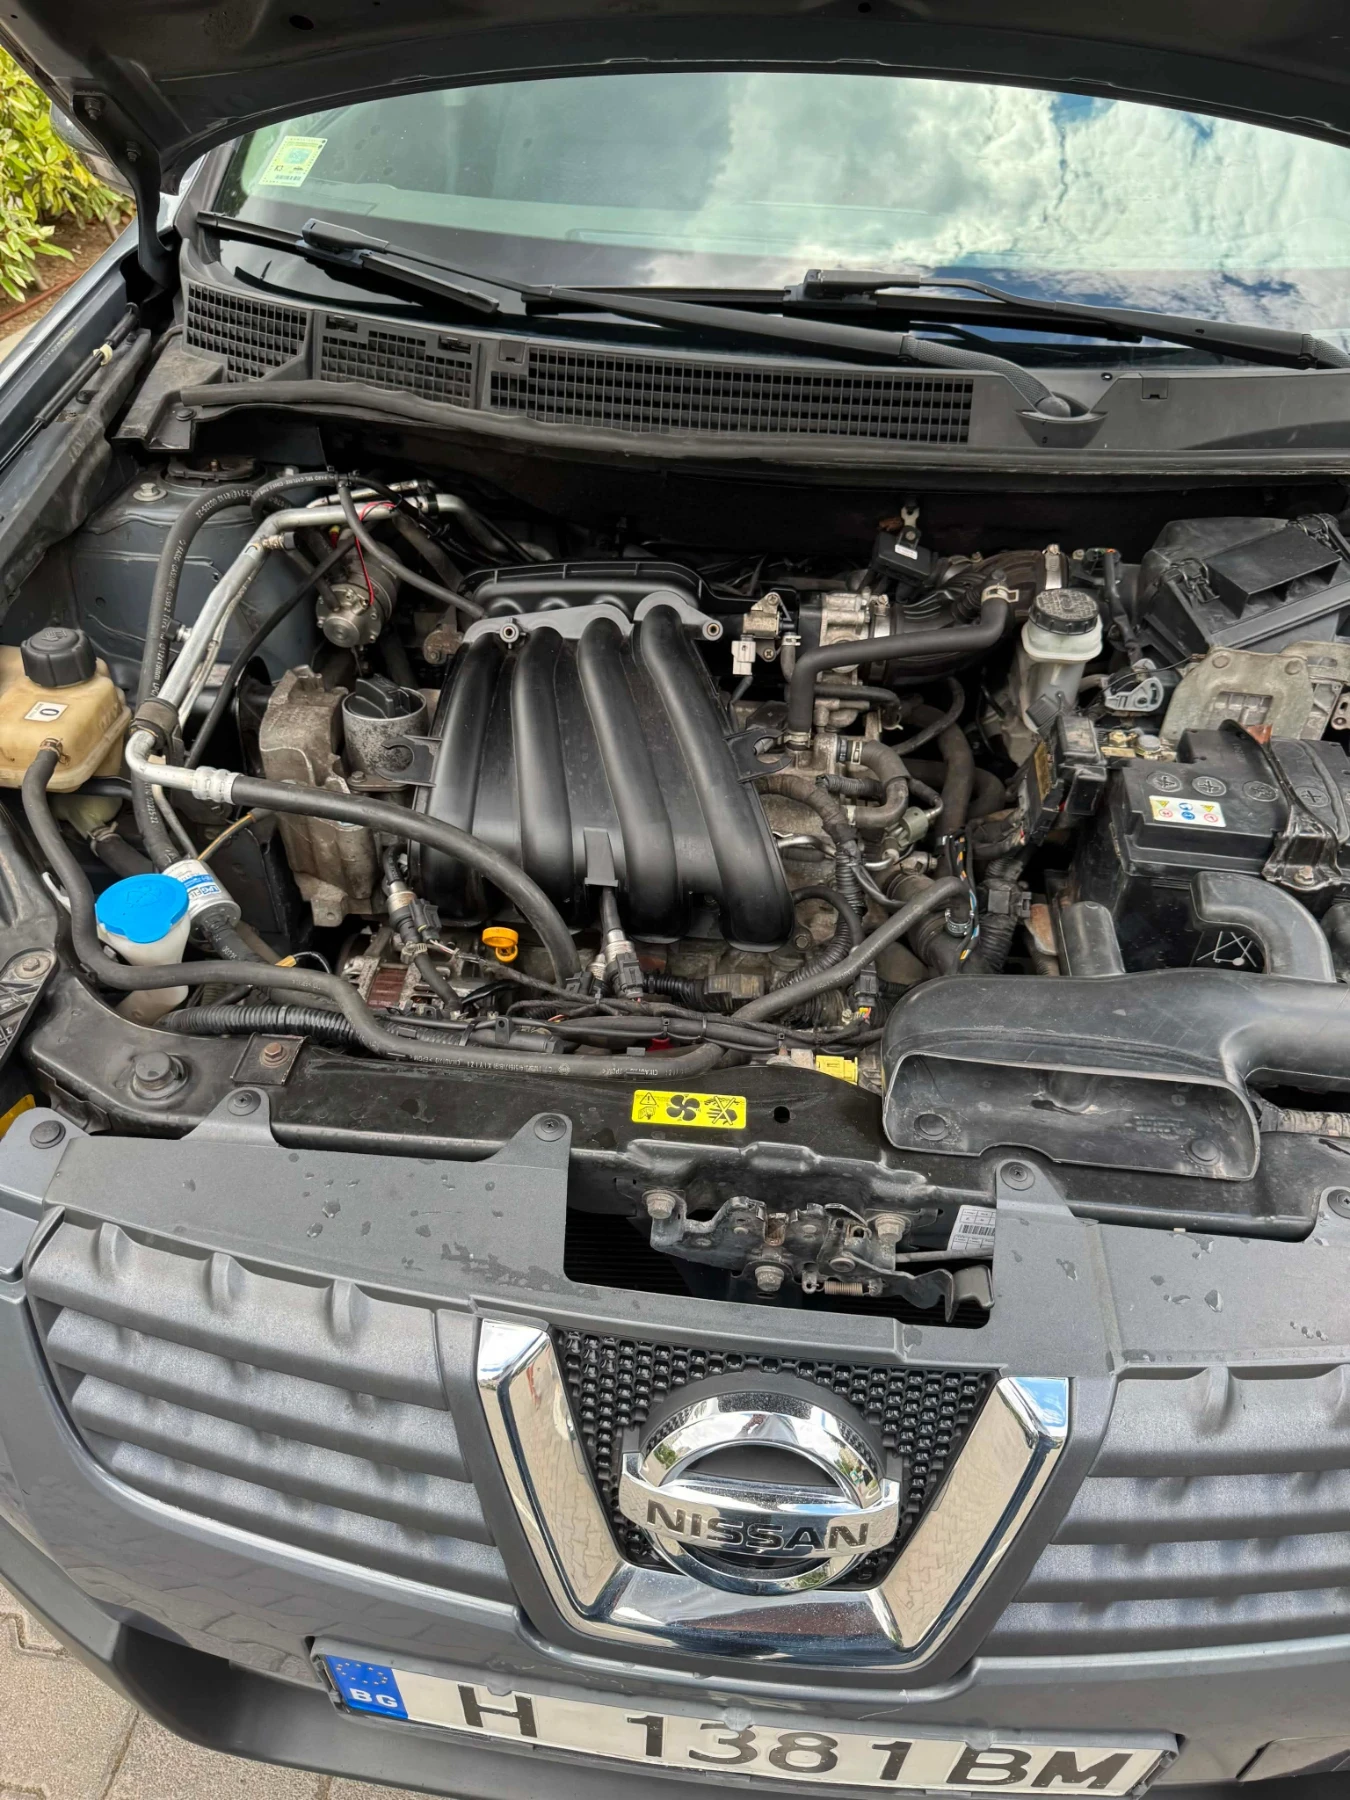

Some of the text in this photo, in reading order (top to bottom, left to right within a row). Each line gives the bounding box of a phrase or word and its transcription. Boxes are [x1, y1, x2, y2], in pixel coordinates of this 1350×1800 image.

[646, 1499, 870, 1552] NISSAN
[349, 1687, 398, 1708] BG
[457, 1684, 1135, 1789] H 1381 BM
